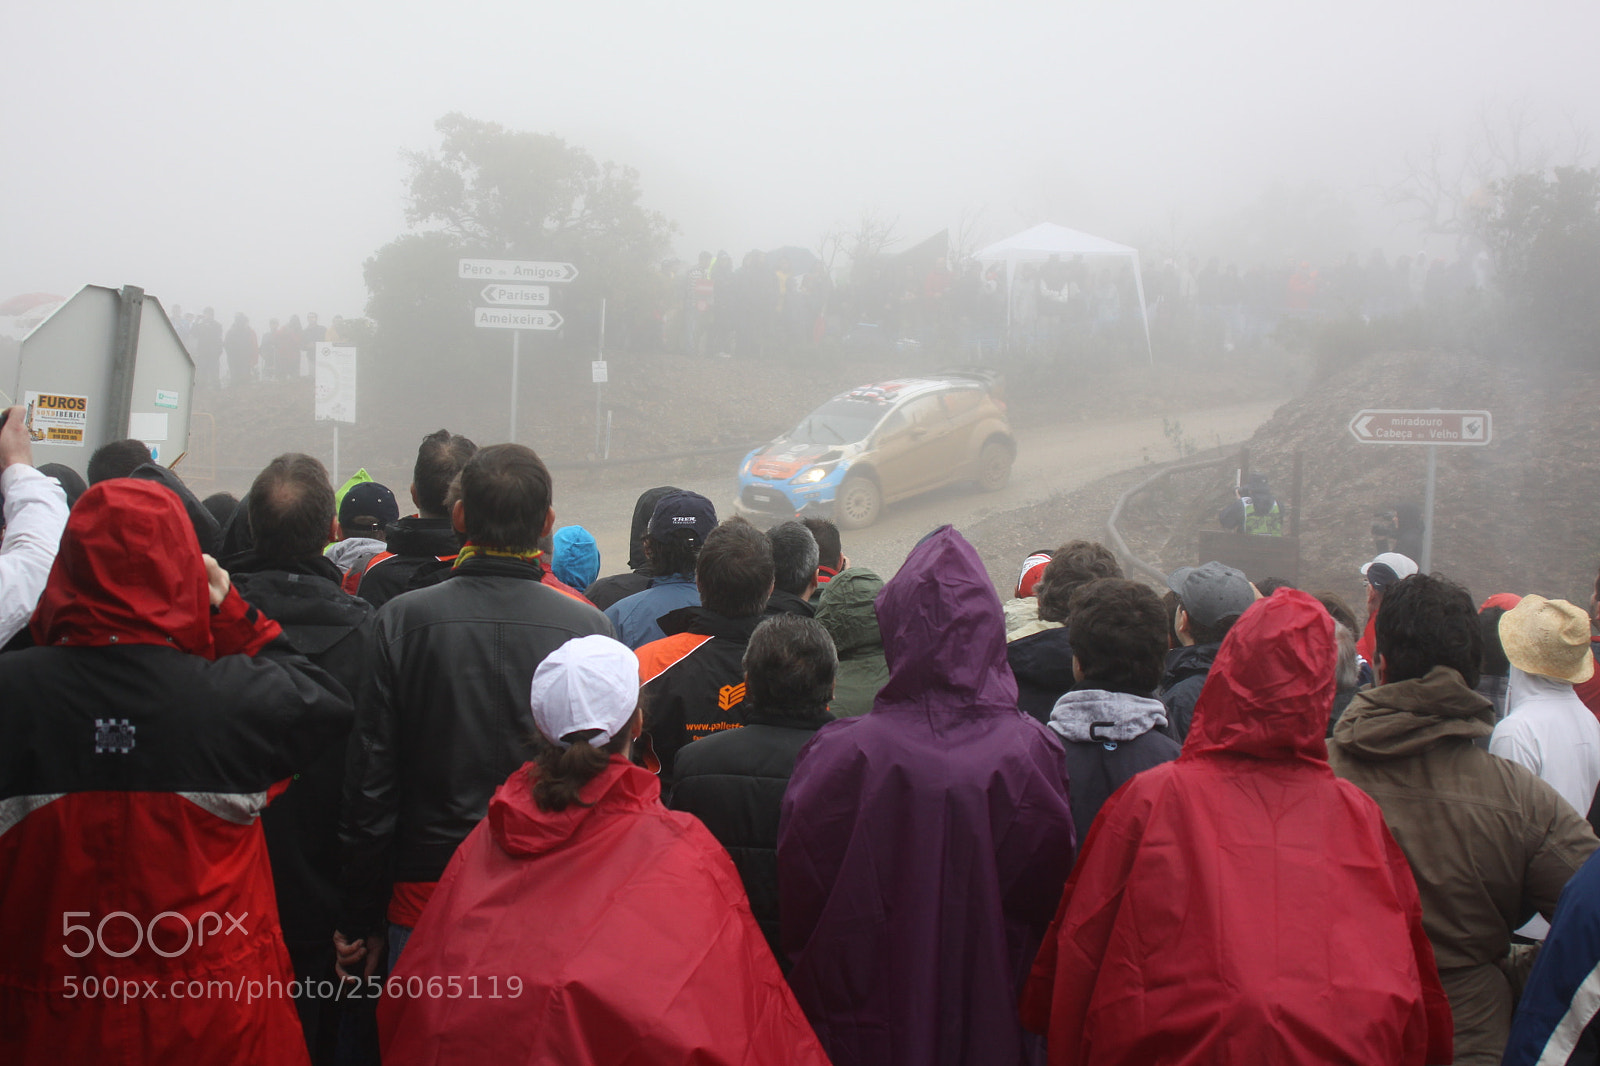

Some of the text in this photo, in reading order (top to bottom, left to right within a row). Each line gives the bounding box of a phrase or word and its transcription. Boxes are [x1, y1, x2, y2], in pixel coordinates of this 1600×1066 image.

[463, 263, 492, 275] Pero
[513, 265, 561, 279] Amigos
[498, 289, 545, 301] Parises
[479, 312, 545, 326] Ameixeira
[39, 395, 86, 410] FUROS
[1391, 416, 1443, 427] miradouro
[1375, 427, 1413, 440] Cabeça
[1430, 428, 1459, 439] Velho
